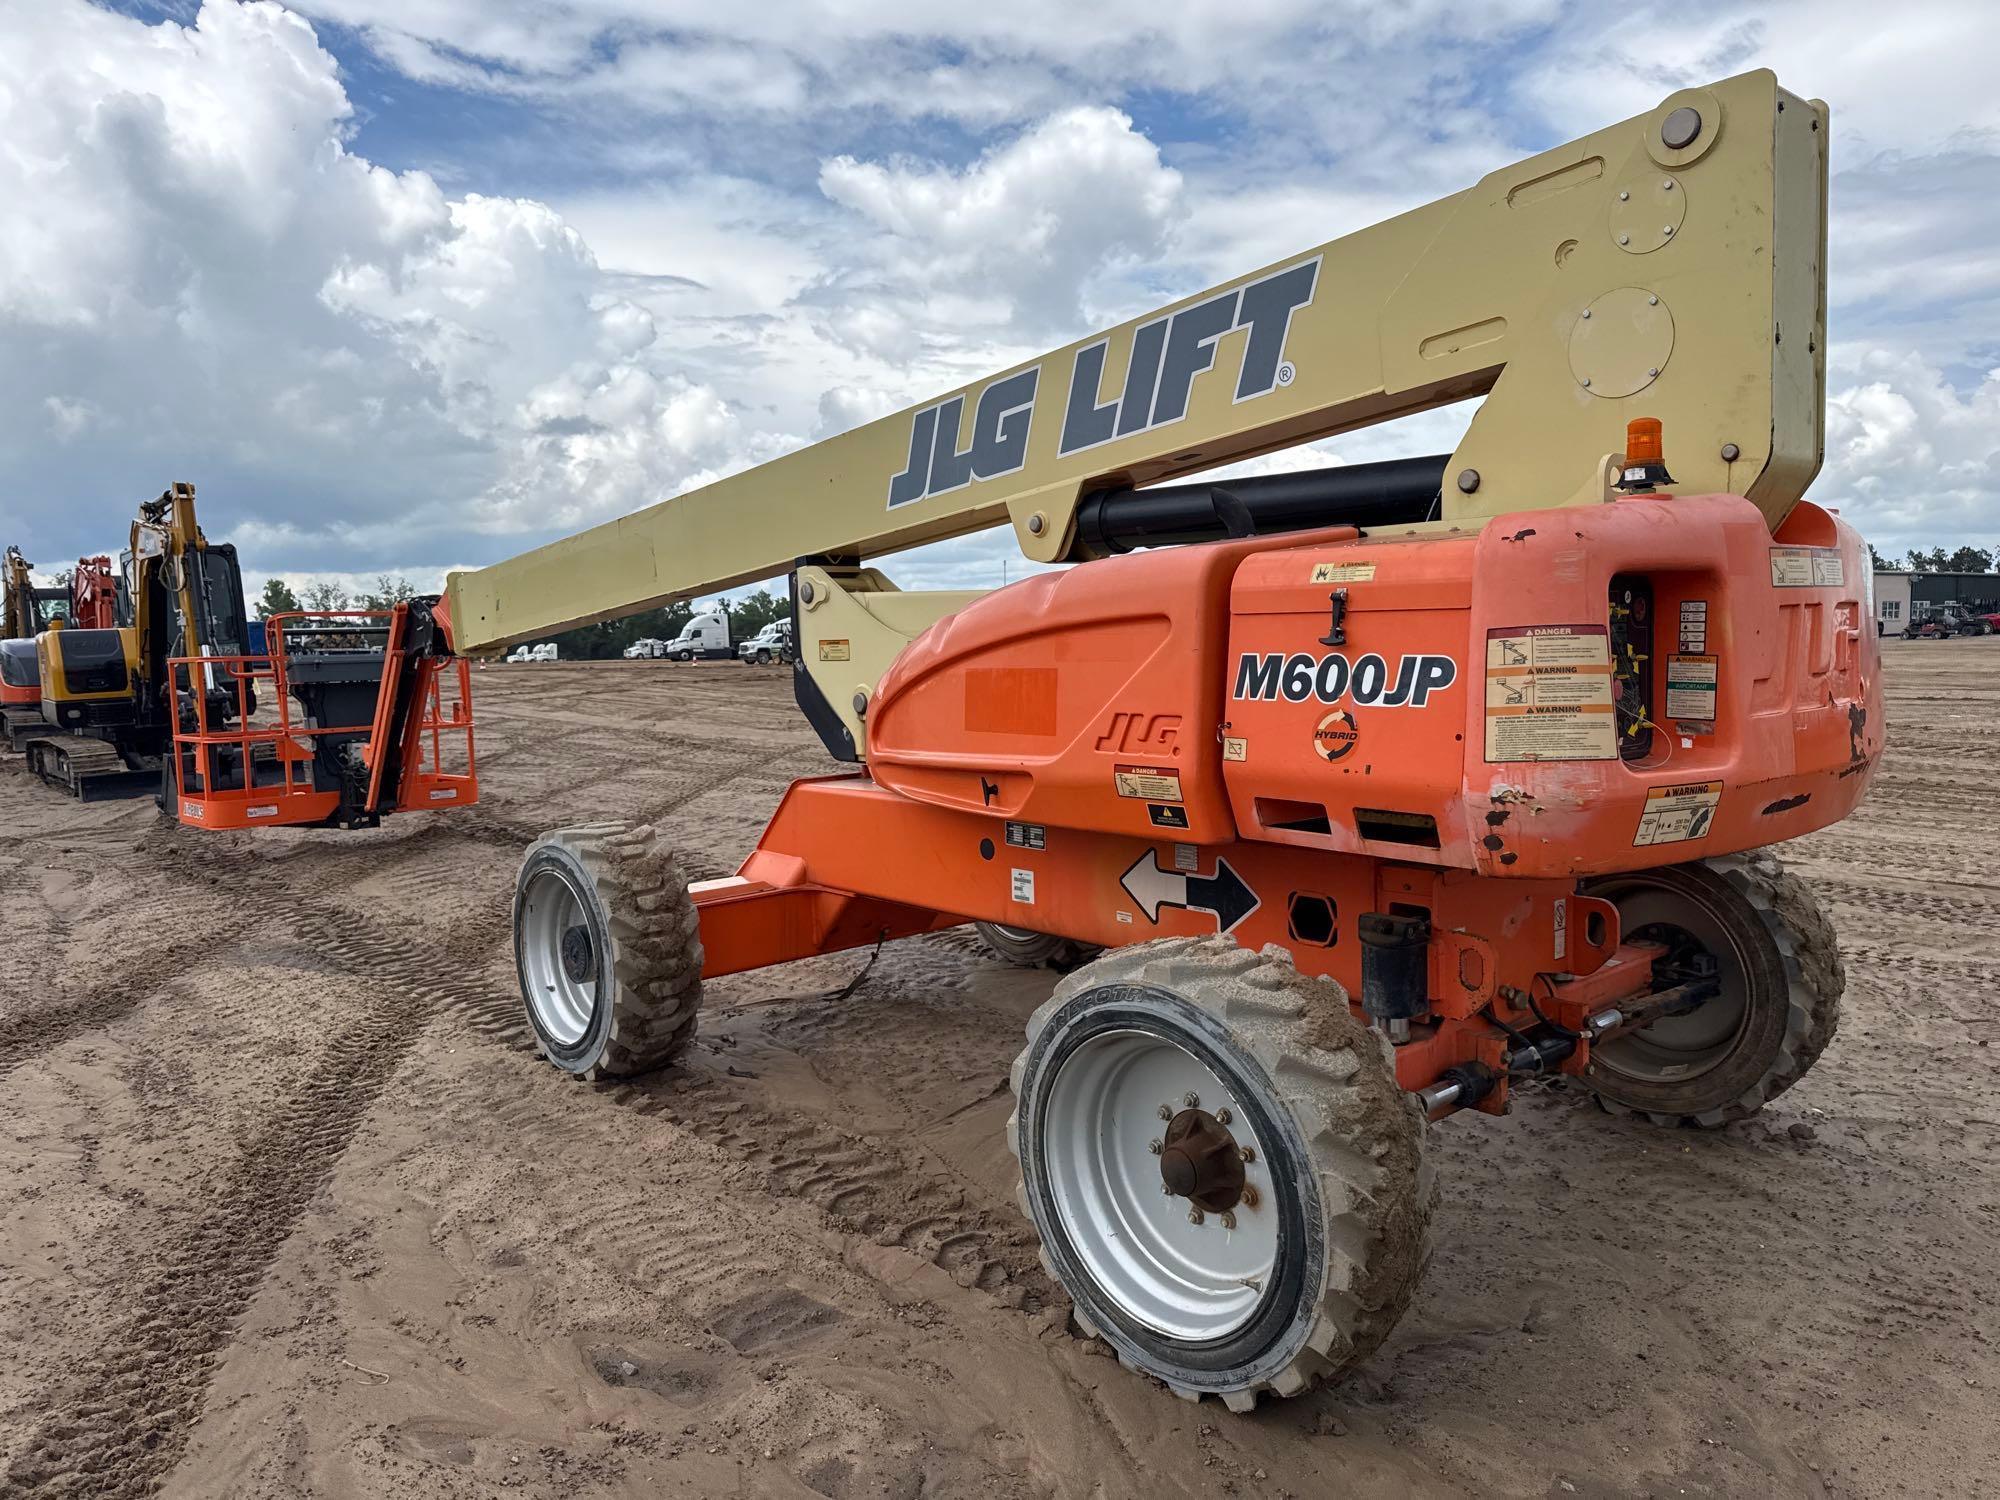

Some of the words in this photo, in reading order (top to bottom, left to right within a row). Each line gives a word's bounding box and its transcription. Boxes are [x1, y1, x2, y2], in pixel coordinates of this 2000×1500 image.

[887, 364, 1042, 511] JLG
[1057, 253, 1323, 460] LIFT
[1534, 628, 1572, 636] DANGER
[1535, 666, 1578, 675] WARNING
[1233, 653, 1457, 708] M600JP
[1535, 706, 1582, 714] WARNING
[1094, 712, 1183, 757] JLG
[1314, 730, 1358, 741] HYBRID
[1672, 785, 1709, 797] WARNING
